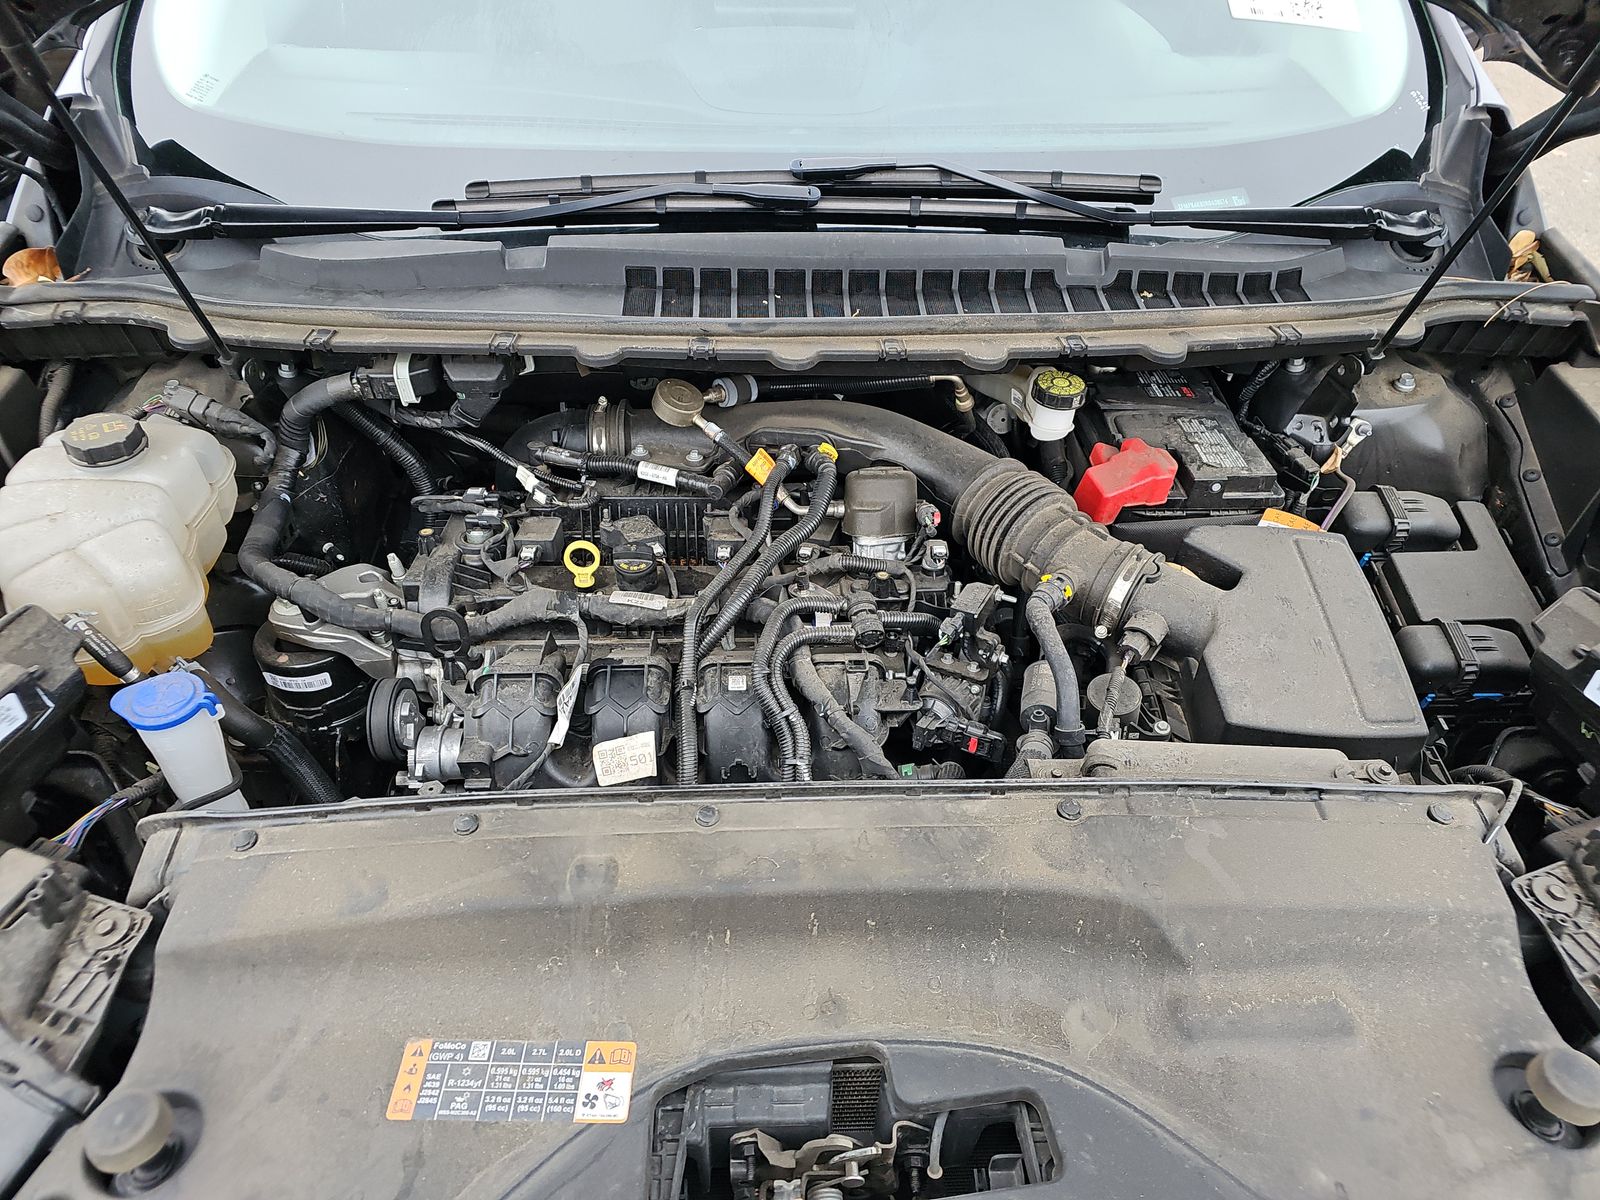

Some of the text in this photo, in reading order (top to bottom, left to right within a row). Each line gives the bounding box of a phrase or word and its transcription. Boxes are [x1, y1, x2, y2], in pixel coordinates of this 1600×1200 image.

[630, 752, 654, 766] 501
[434, 1042, 466, 1050] FoMoCo
[455, 1053, 463, 1061] 4)
[509, 1068, 517, 1076] kg
[541, 1069, 549, 1077] kg
[572, 1069, 580, 1077] kg
[448, 1080, 482, 1088] R-1234yf
[497, 1105, 508, 1113] cc)
[530, 1105, 540, 1113] cc)
